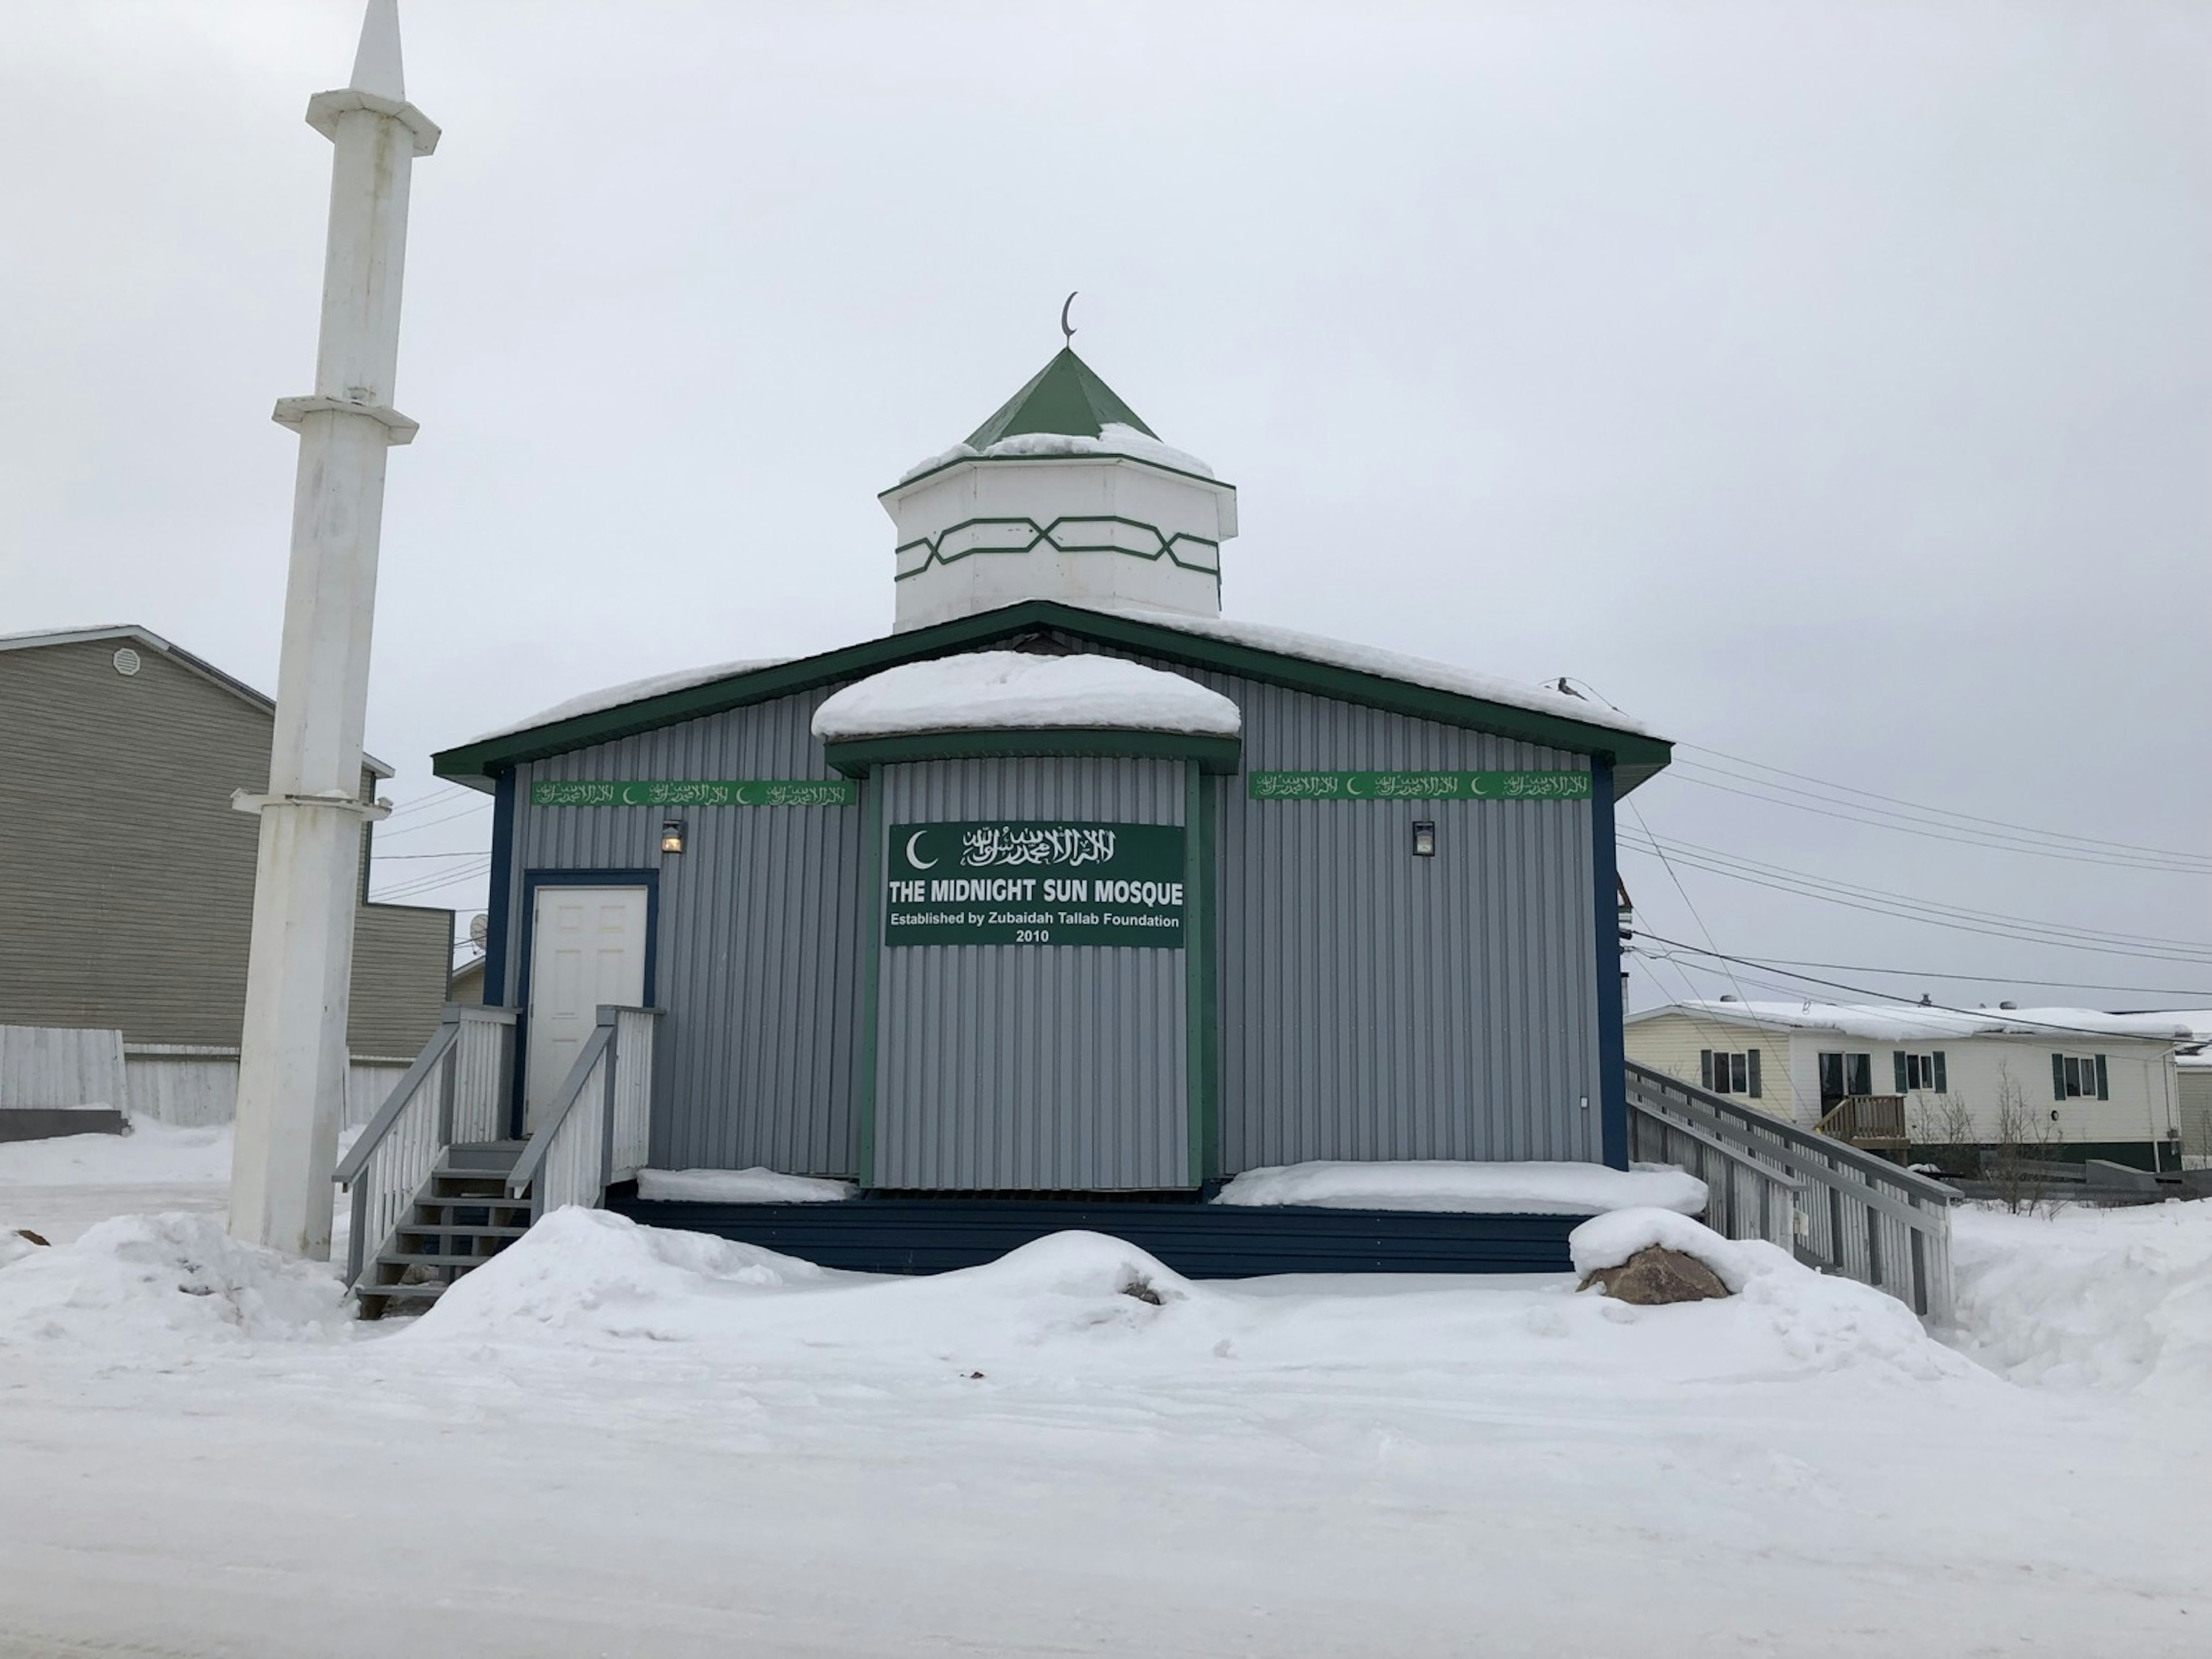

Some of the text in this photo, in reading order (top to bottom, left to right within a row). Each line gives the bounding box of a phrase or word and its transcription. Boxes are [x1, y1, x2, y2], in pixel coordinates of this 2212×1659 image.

[890, 879, 1183, 907] THE MIDNIGHT SUN MOSQUE
[891, 912, 1179, 927] Established by Zubaidah Tallab Foundation
[1017, 930, 1048, 942] 2010
